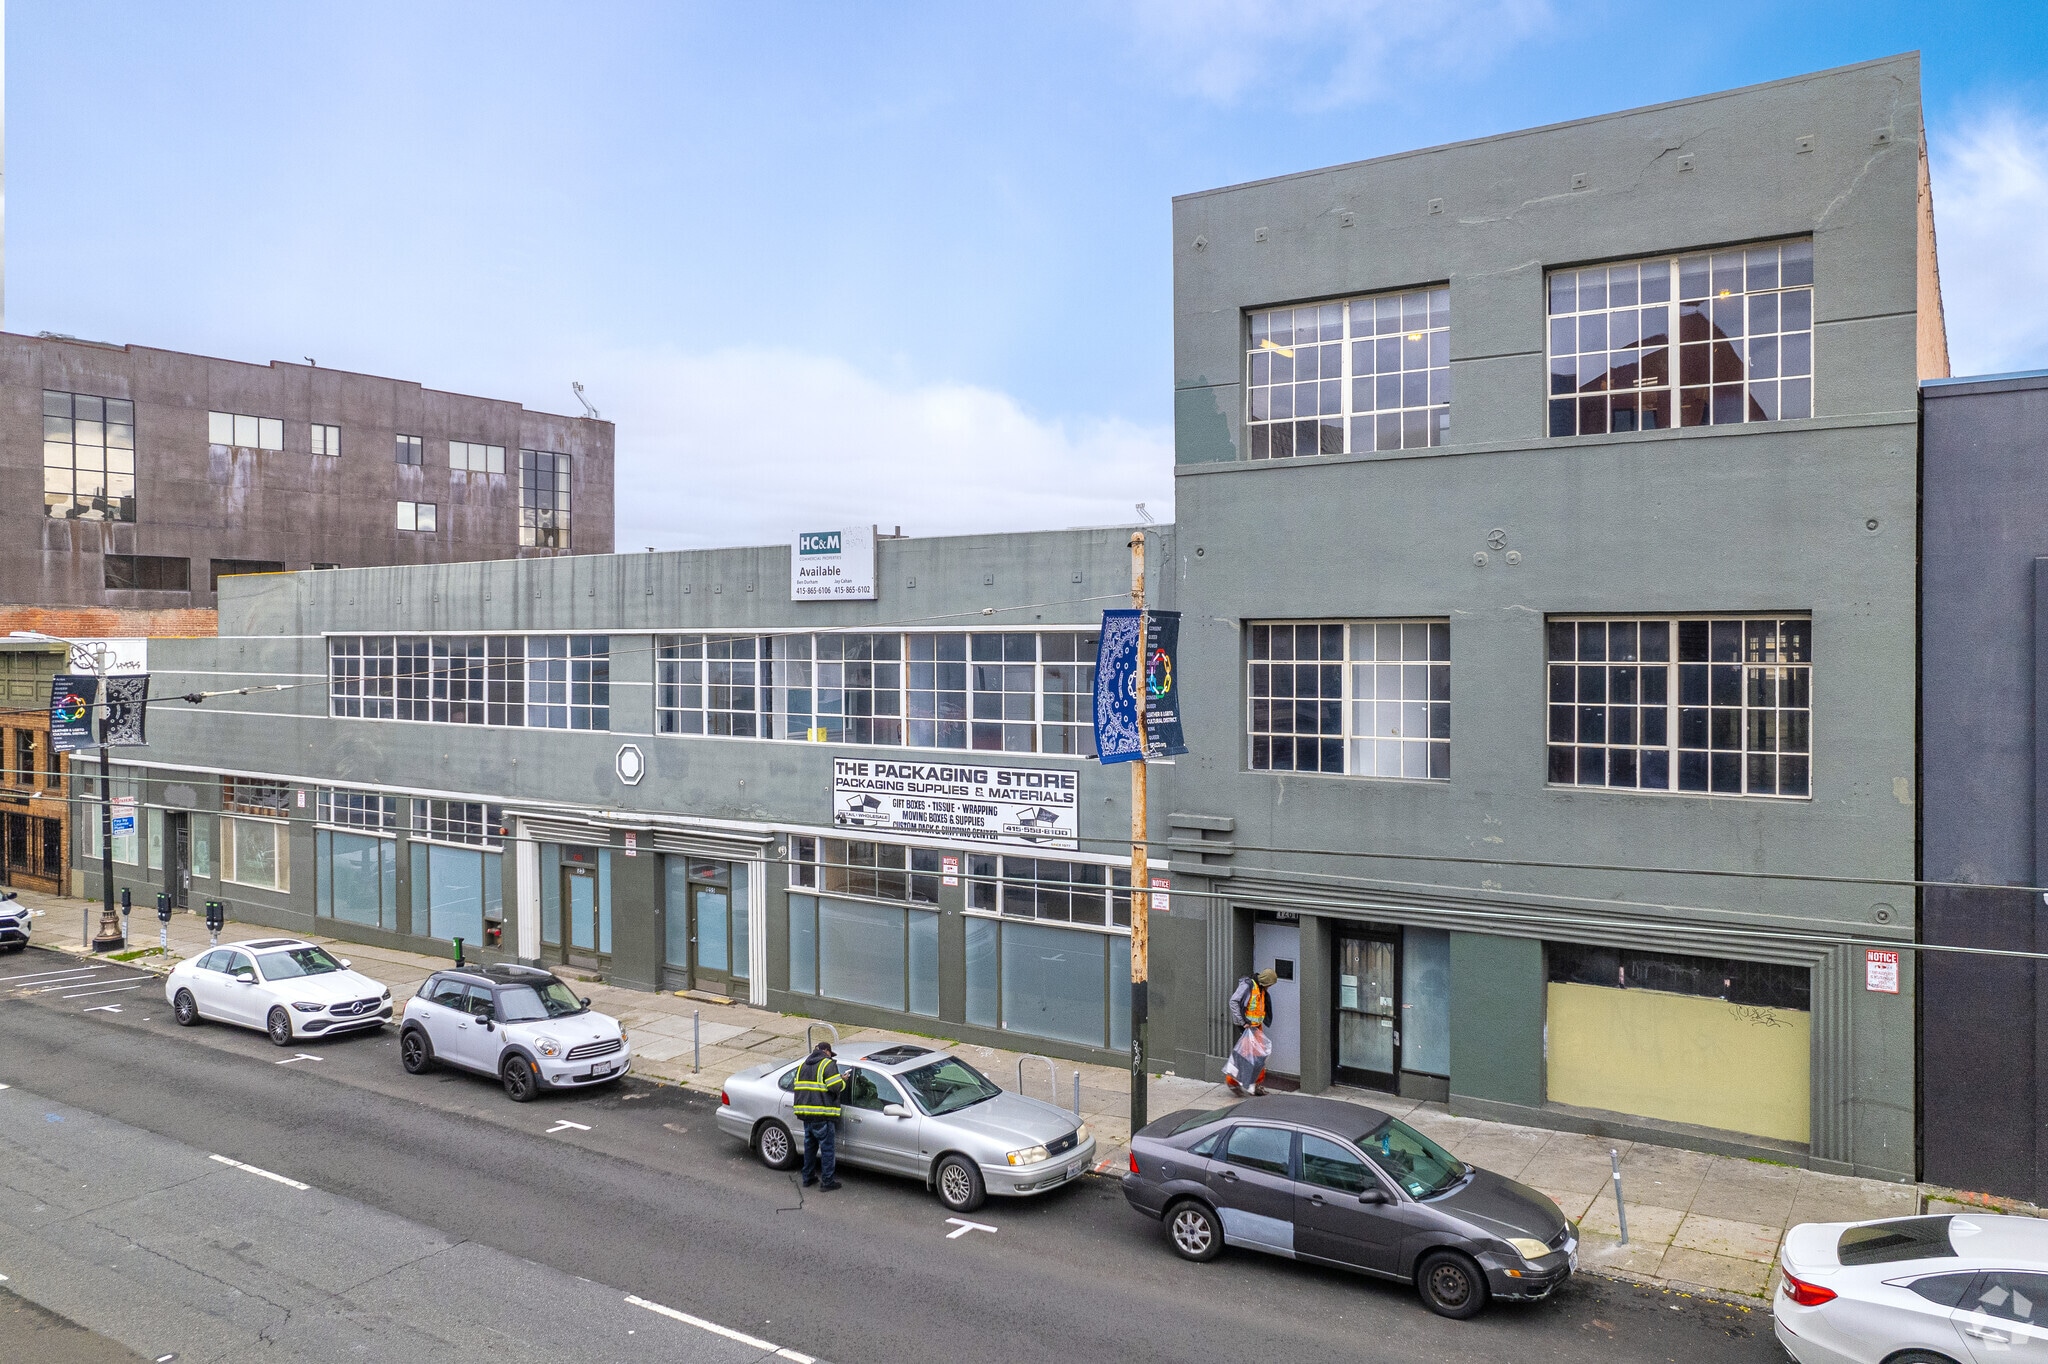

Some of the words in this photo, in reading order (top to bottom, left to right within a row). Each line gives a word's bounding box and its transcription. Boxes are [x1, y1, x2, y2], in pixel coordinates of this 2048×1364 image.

[801, 535, 840, 550] HC&M
[800, 565, 841, 576] Available
[836, 762, 868, 776] THE
[875, 764, 988, 784] PACKAGING
[997, 771, 1074, 789] STORE
[836, 778, 903, 791] PACKAGING
[908, 783, 968, 795] SUPPLIES
[975, 788, 984, 797] &
[989, 788, 1074, 803] MATERIALS
[893, 799, 904, 808] GIFT
[906, 800, 925, 809] BOXES
[932, 802, 955, 812] TISSUE
[962, 804, 997, 816] WRAPPING
[902, 811, 927, 822] MOVING
[929, 813, 948, 823] BOXES
[950, 815, 955, 824] &
[956, 816, 984, 826] SUPPLIES
[893, 821, 916, 832] CUSTOM
[919, 824, 934, 834] PACK
[972, 828, 998, 840] CENTER
[1152, 880, 1169, 888] NOTICE
[1868, 951, 1896, 963] NOTICE
